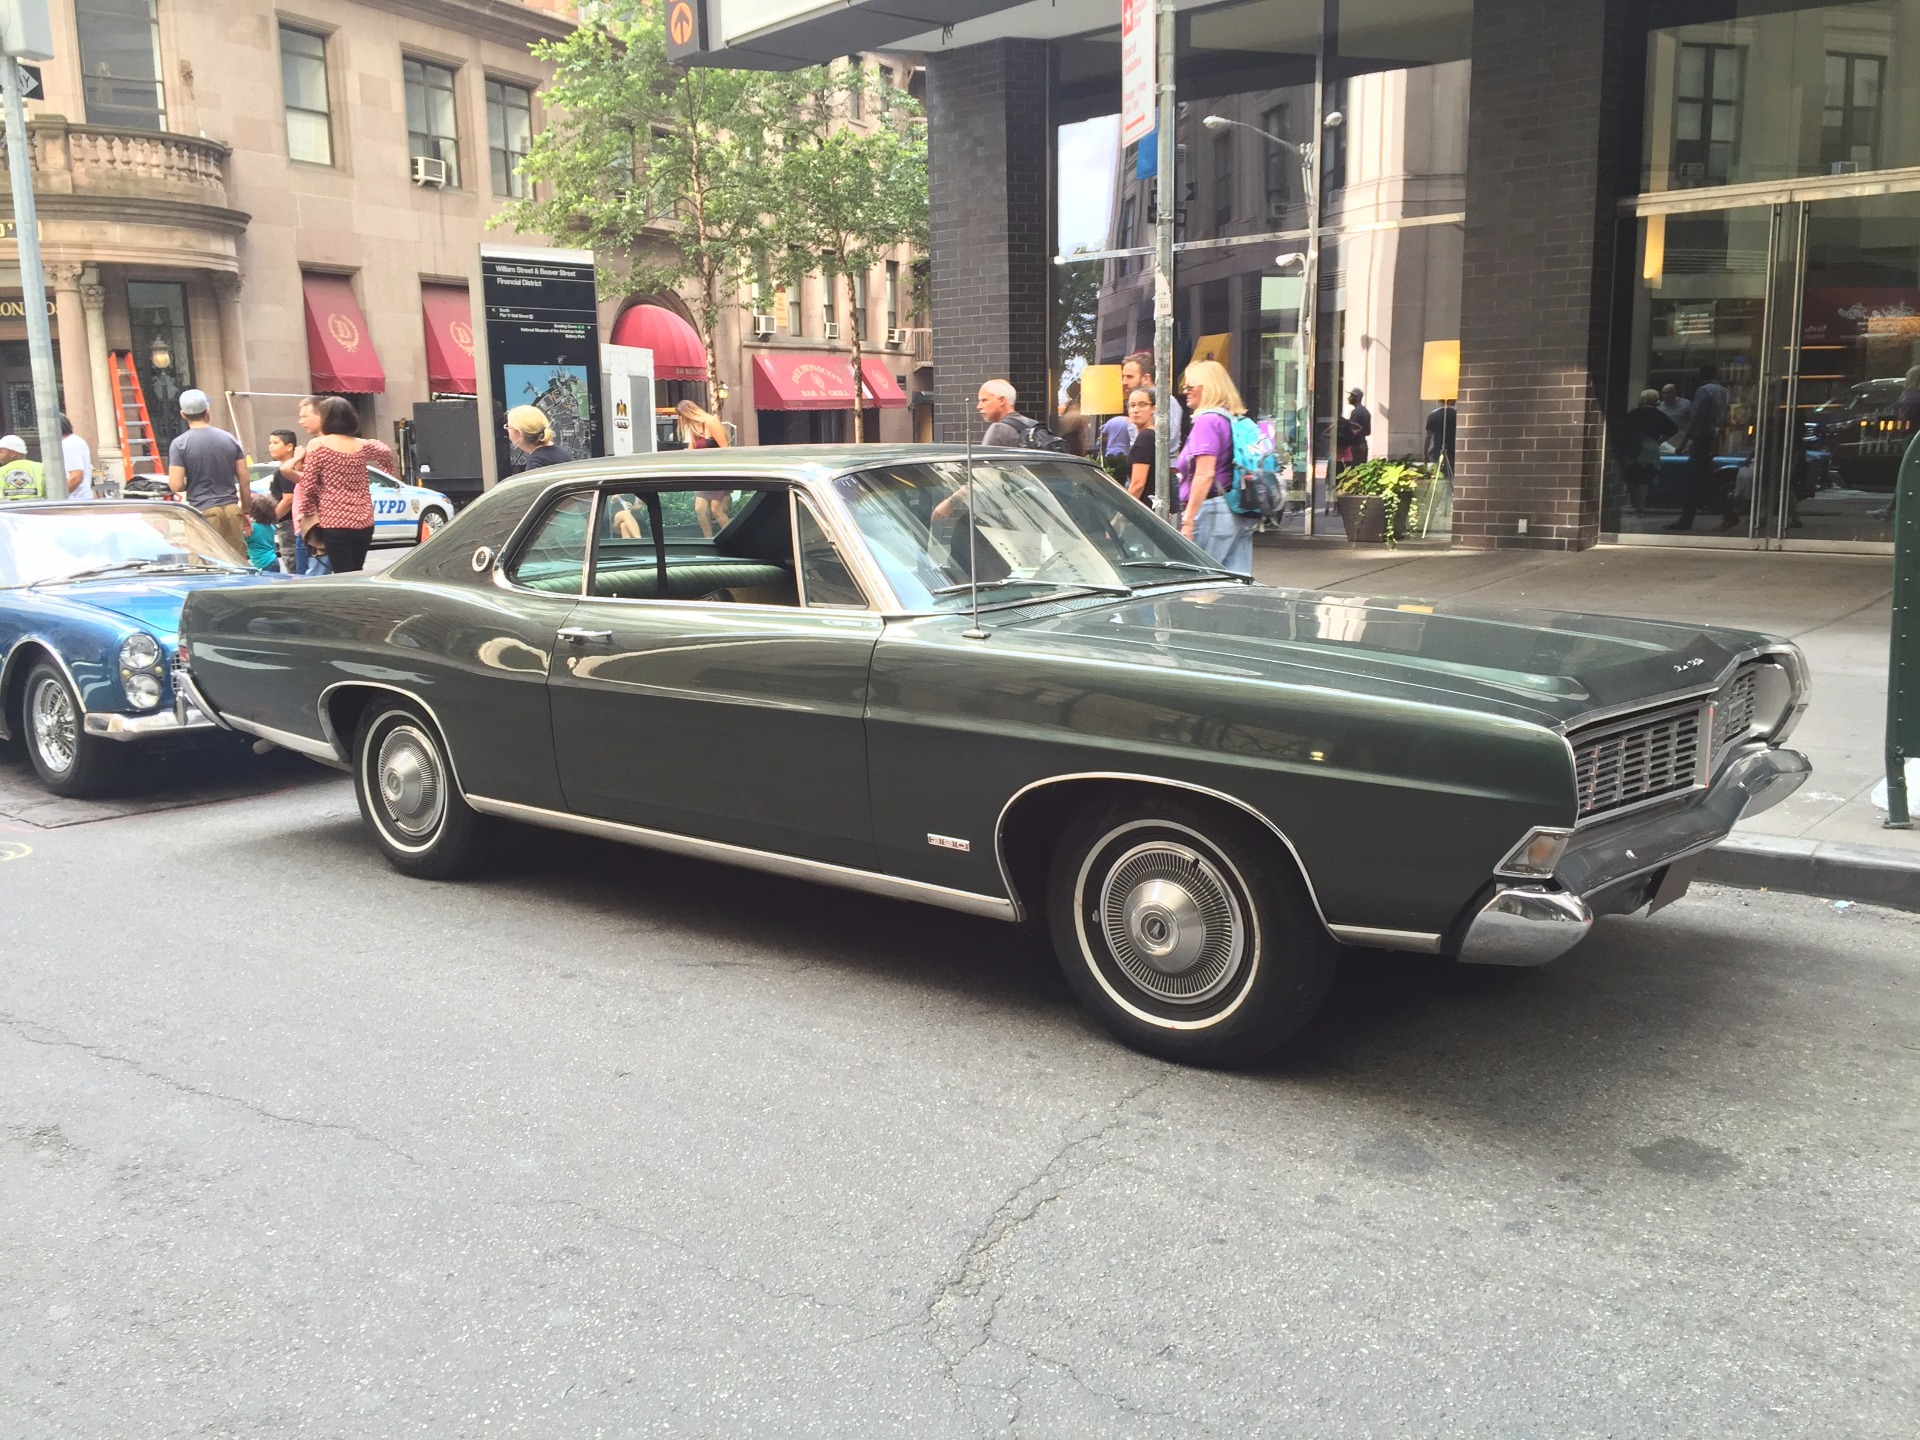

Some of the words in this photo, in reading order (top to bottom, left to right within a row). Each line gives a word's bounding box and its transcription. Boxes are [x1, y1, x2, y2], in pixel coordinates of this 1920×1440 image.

[18, 75, 30, 88] AY
[495, 265, 516, 273] William
[516, 266, 534, 274] Street
[534, 267, 540, 275] &
[540, 268, 559, 276] Beaver
[559, 269, 577, 277] Street
[496, 278, 521, 286] Financial
[522, 279, 542, 287] District
